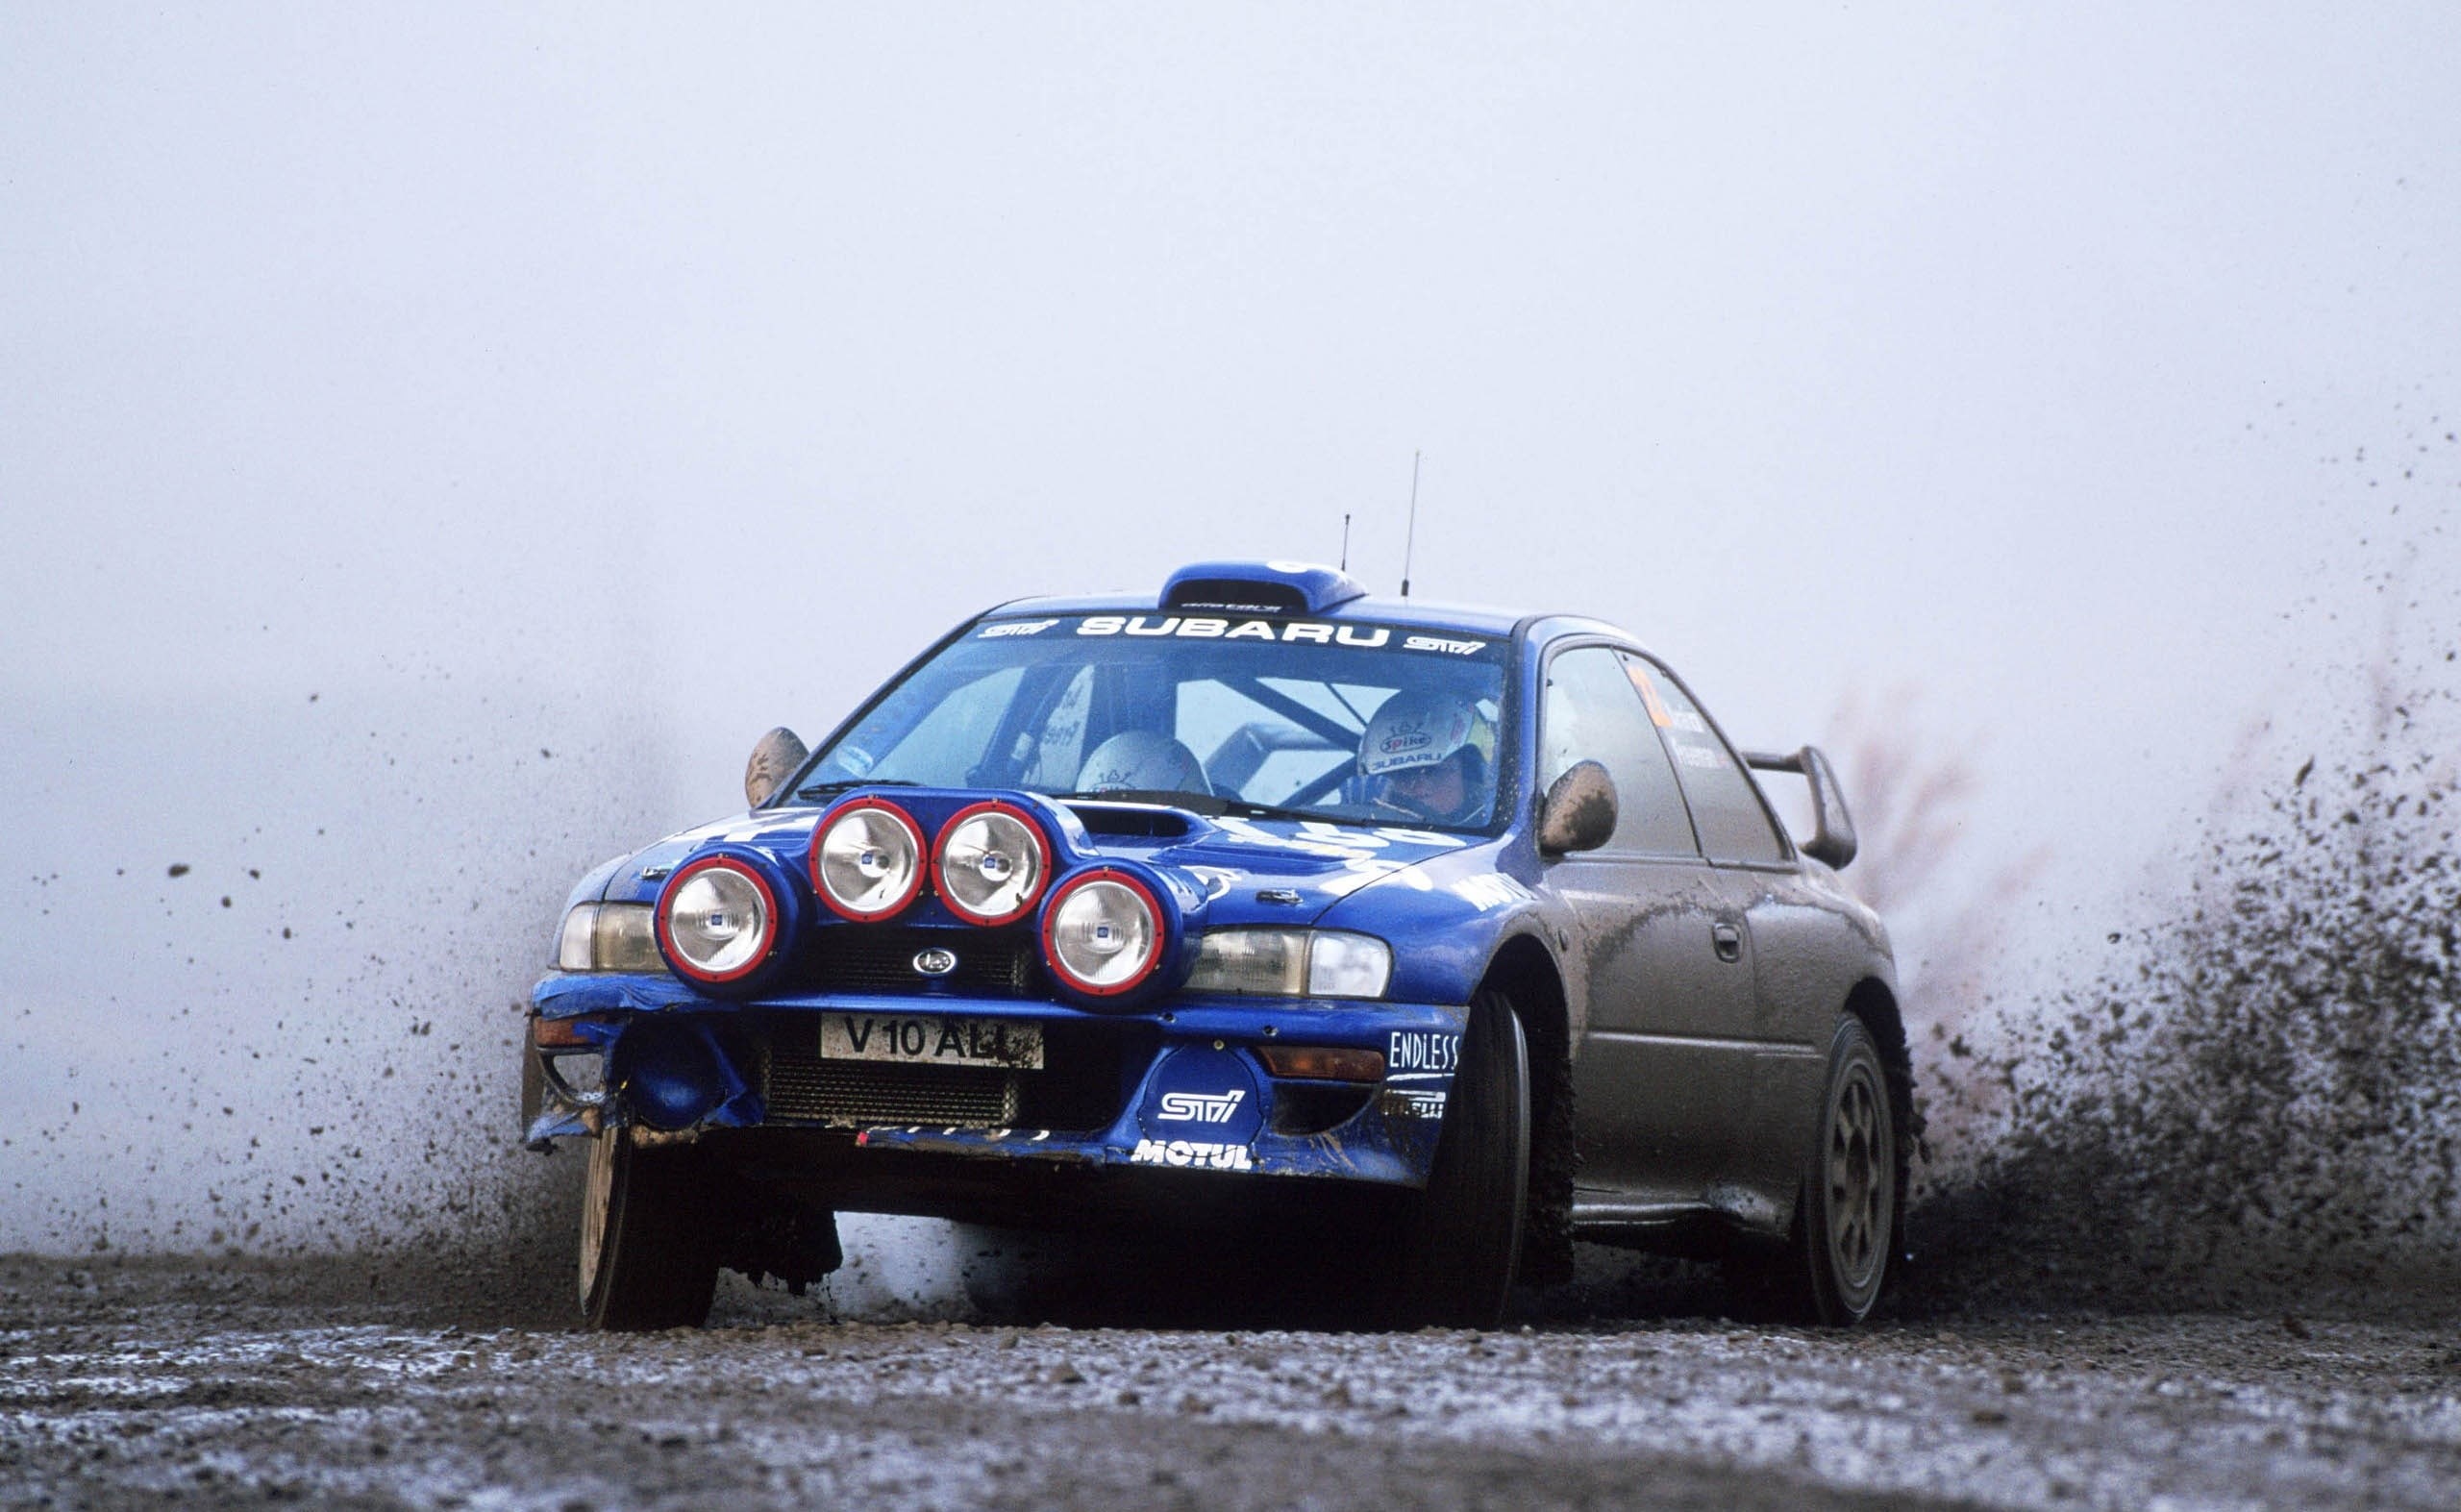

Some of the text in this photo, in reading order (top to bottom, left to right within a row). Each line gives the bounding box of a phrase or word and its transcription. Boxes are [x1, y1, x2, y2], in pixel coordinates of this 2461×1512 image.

[1076, 615, 1390, 648] SUBARU
[1389, 1031, 1459, 1071] ENDLESS
[1130, 1138, 1253, 1170] MOTUL
